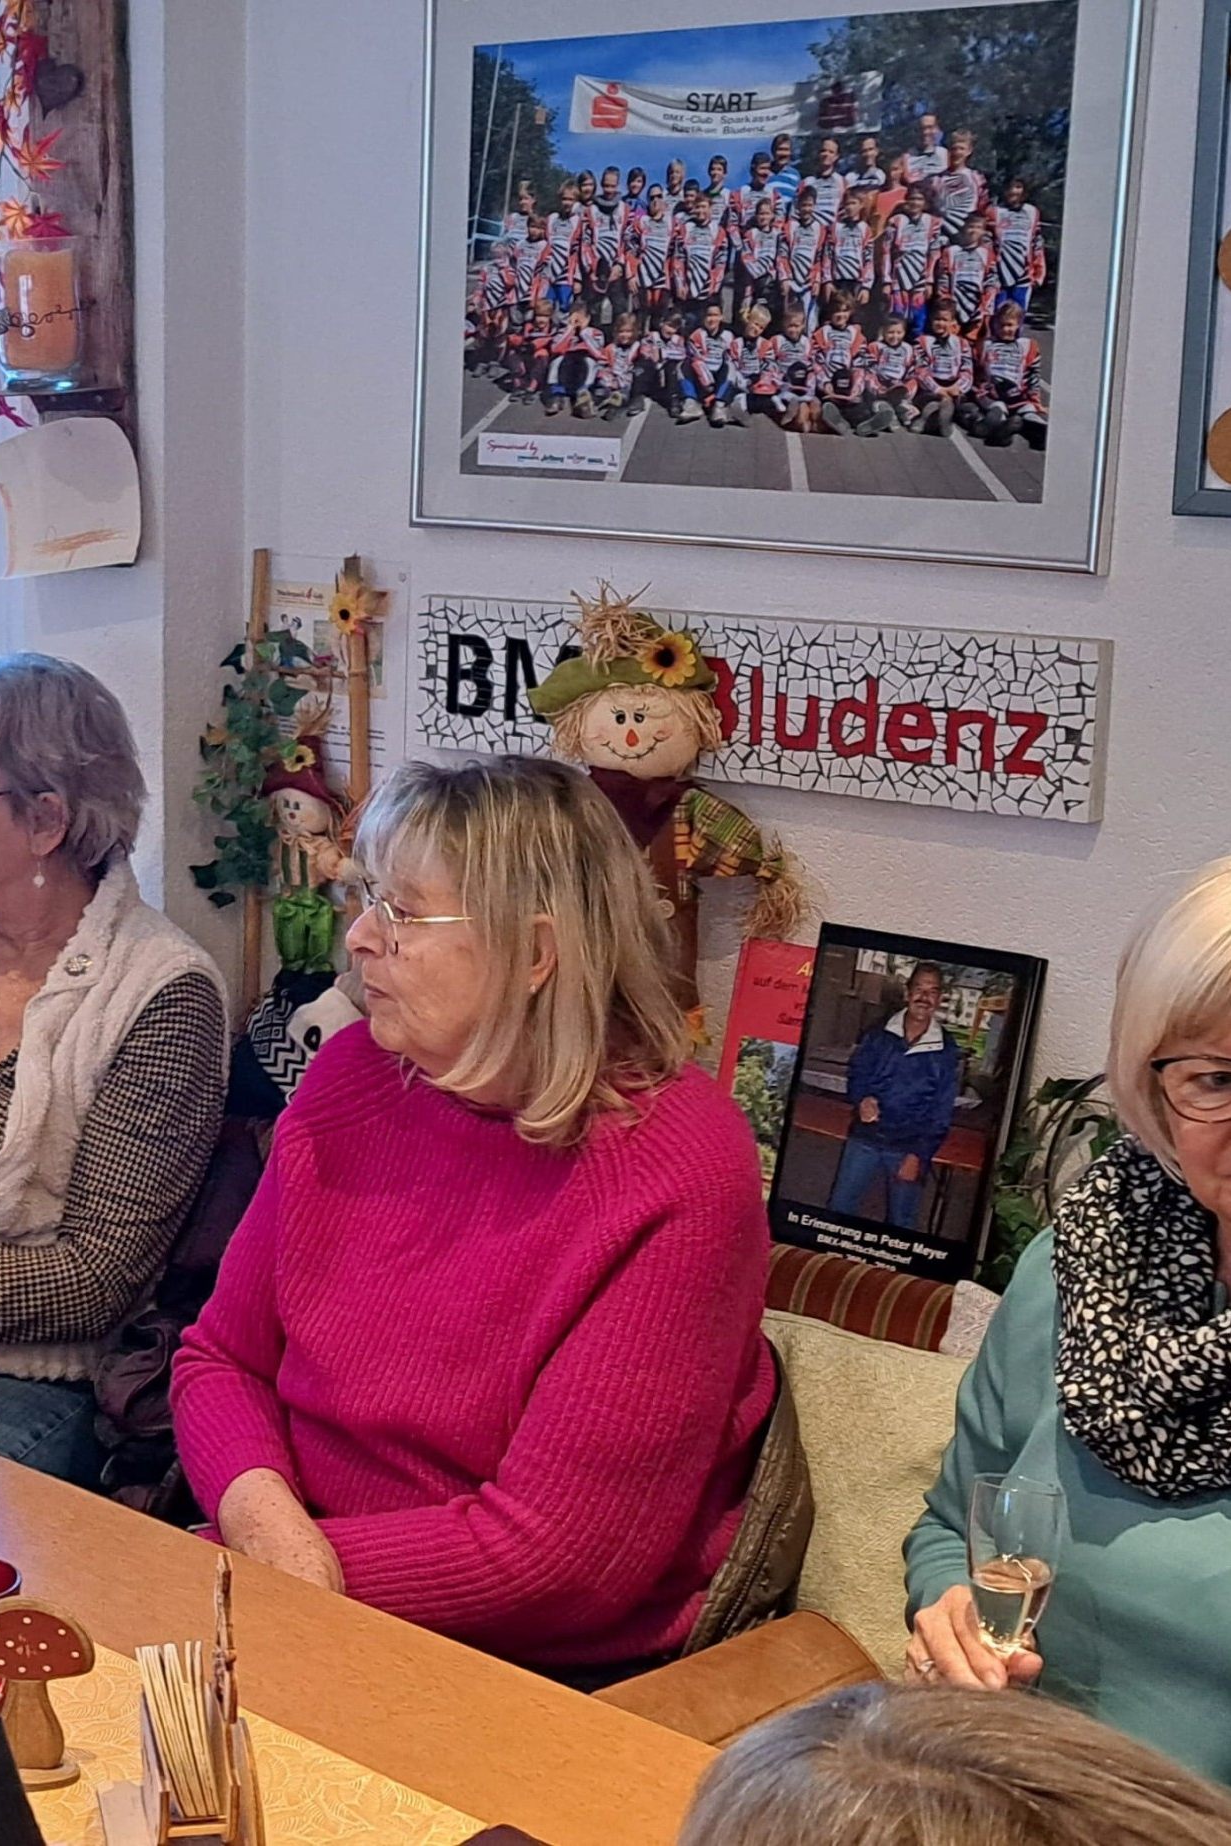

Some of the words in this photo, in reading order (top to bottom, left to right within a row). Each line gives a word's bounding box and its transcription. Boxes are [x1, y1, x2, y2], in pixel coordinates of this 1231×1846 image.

[686, 92, 758, 112] START
[720, 115, 779, 124] Sparkasse
[446, 634, 583, 724] BM
[787, 1211, 799, 1223] In
[800, 1215, 862, 1241] Erinnerung
[863, 1232, 878, 1242] an
[880, 1235, 911, 1250] Peter
[912, 1242, 949, 1260] Meyer
